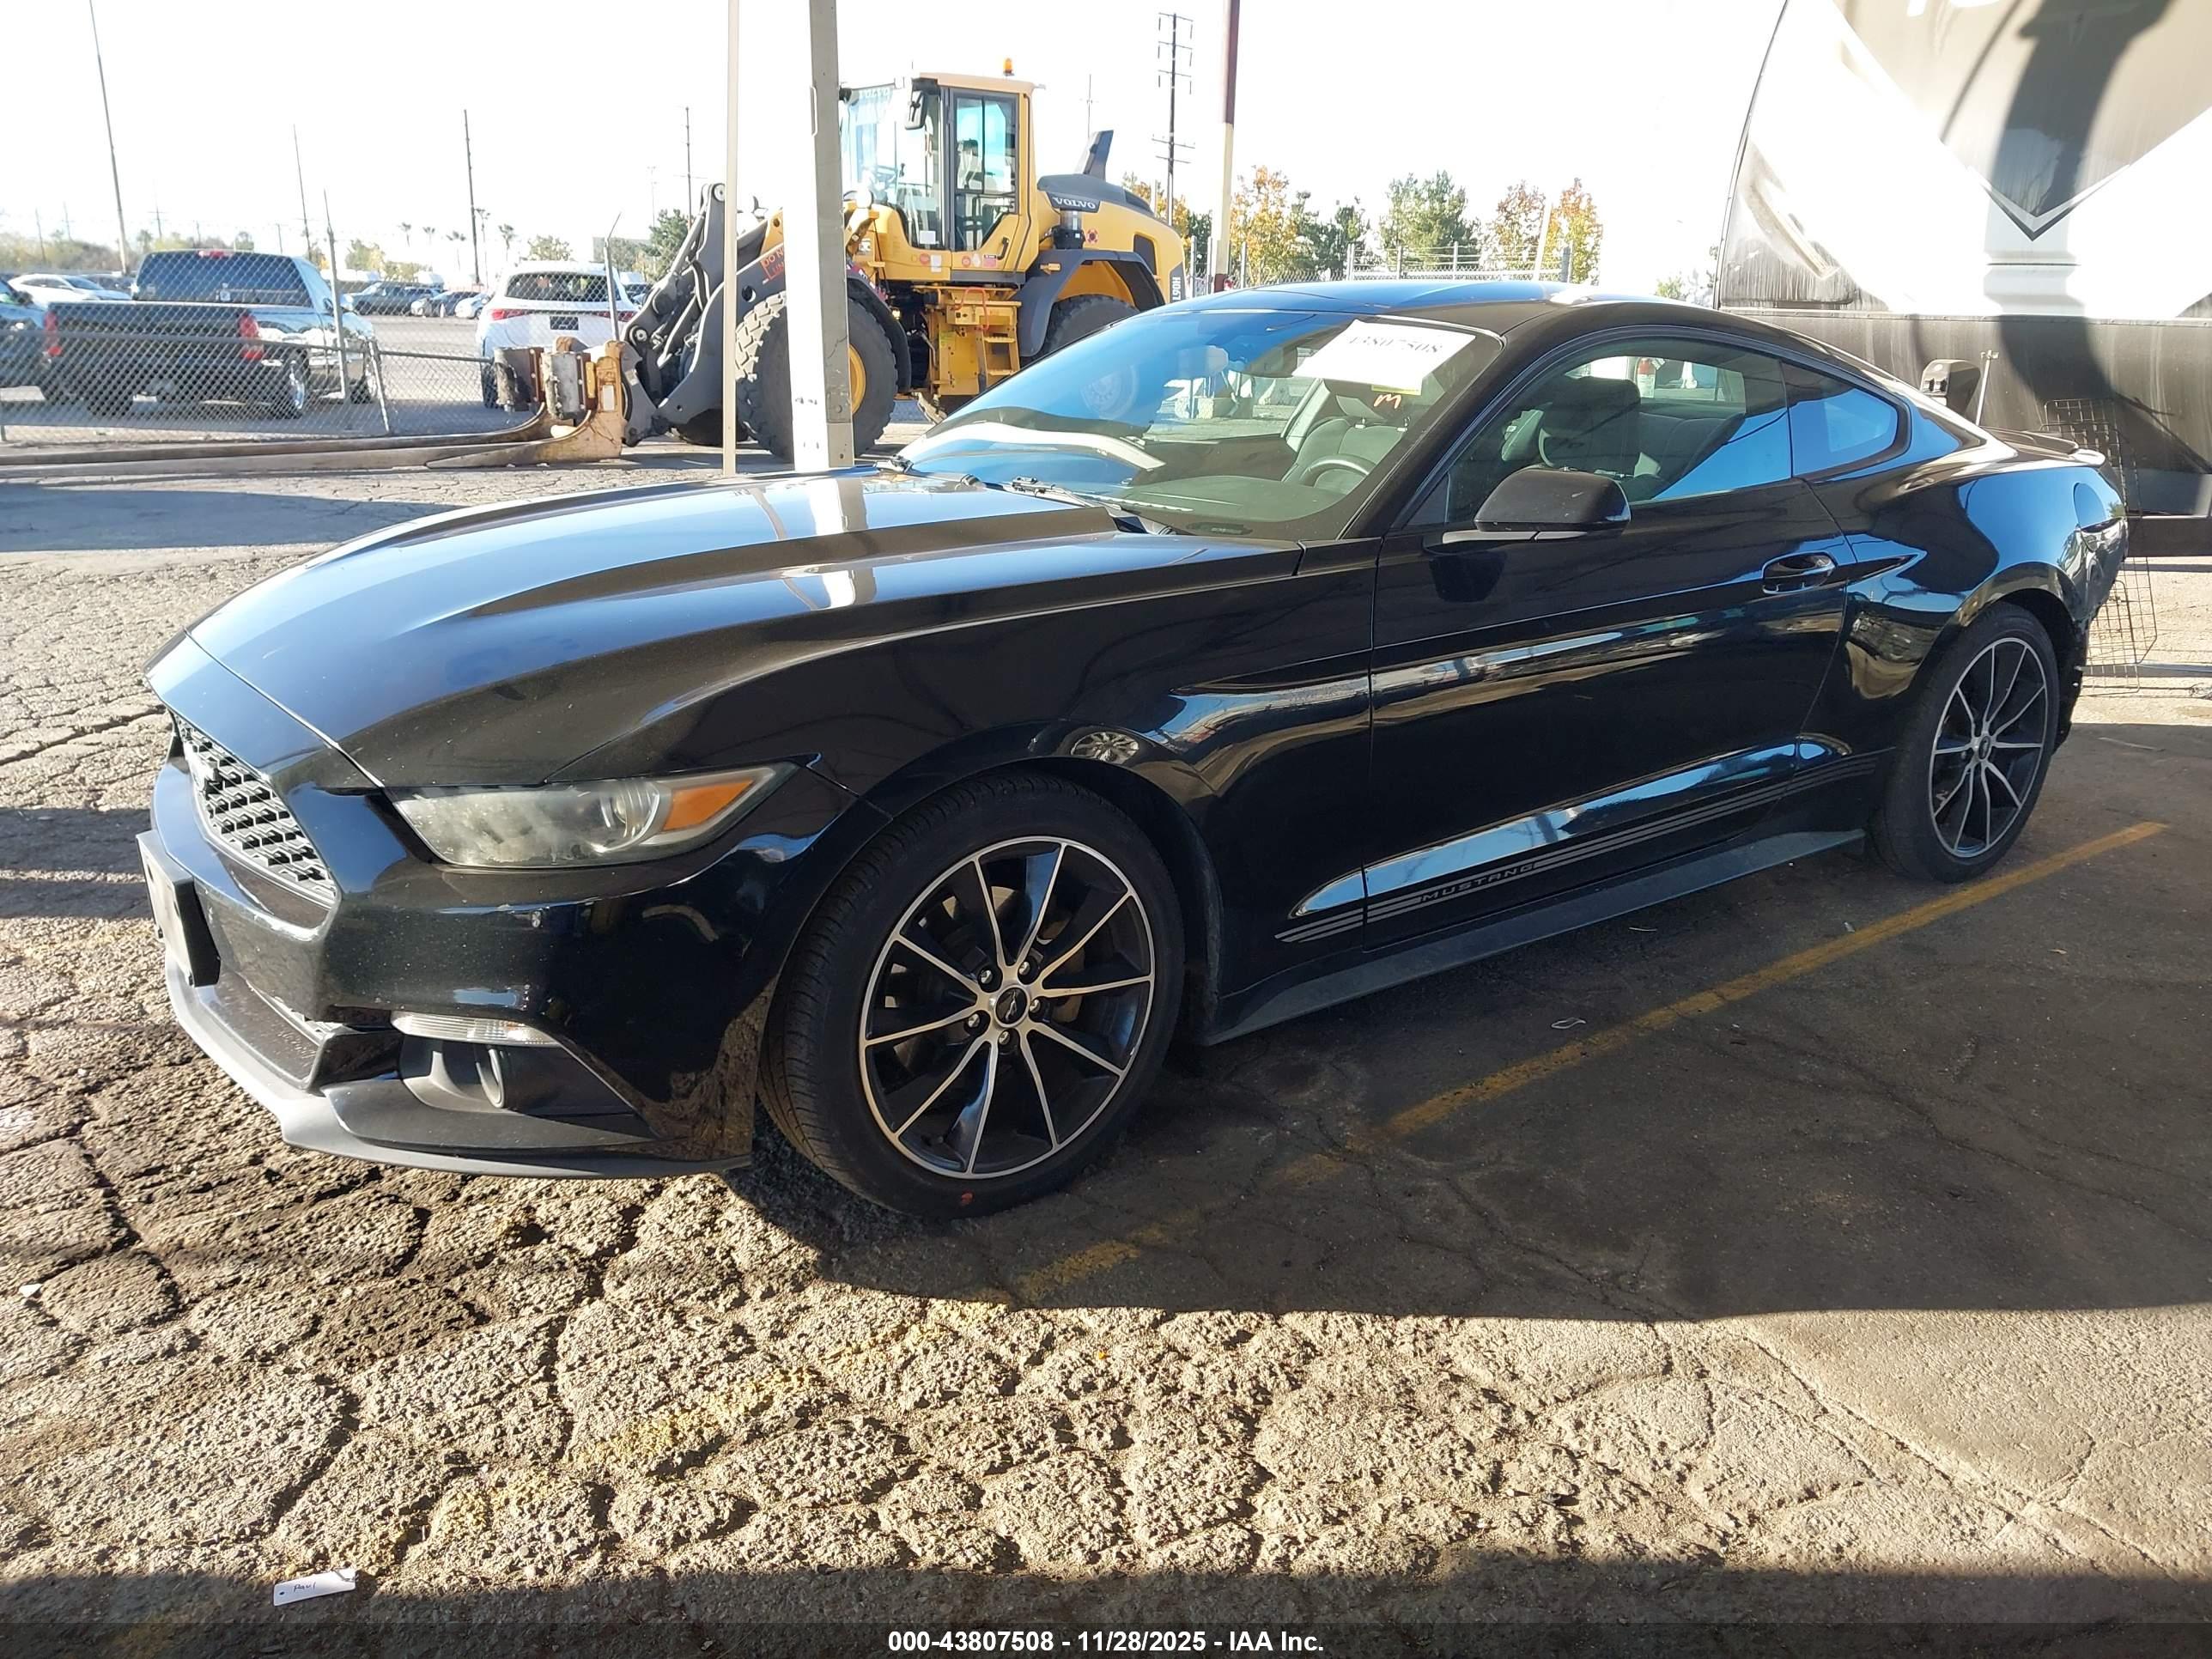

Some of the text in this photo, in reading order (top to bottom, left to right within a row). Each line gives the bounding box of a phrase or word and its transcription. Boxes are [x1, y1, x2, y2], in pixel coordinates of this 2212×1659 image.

[1052, 197, 1096, 210] VOLVO
[1171, 276, 1182, 301] L90H
[1421, 866, 1532, 902] MUSTANG
